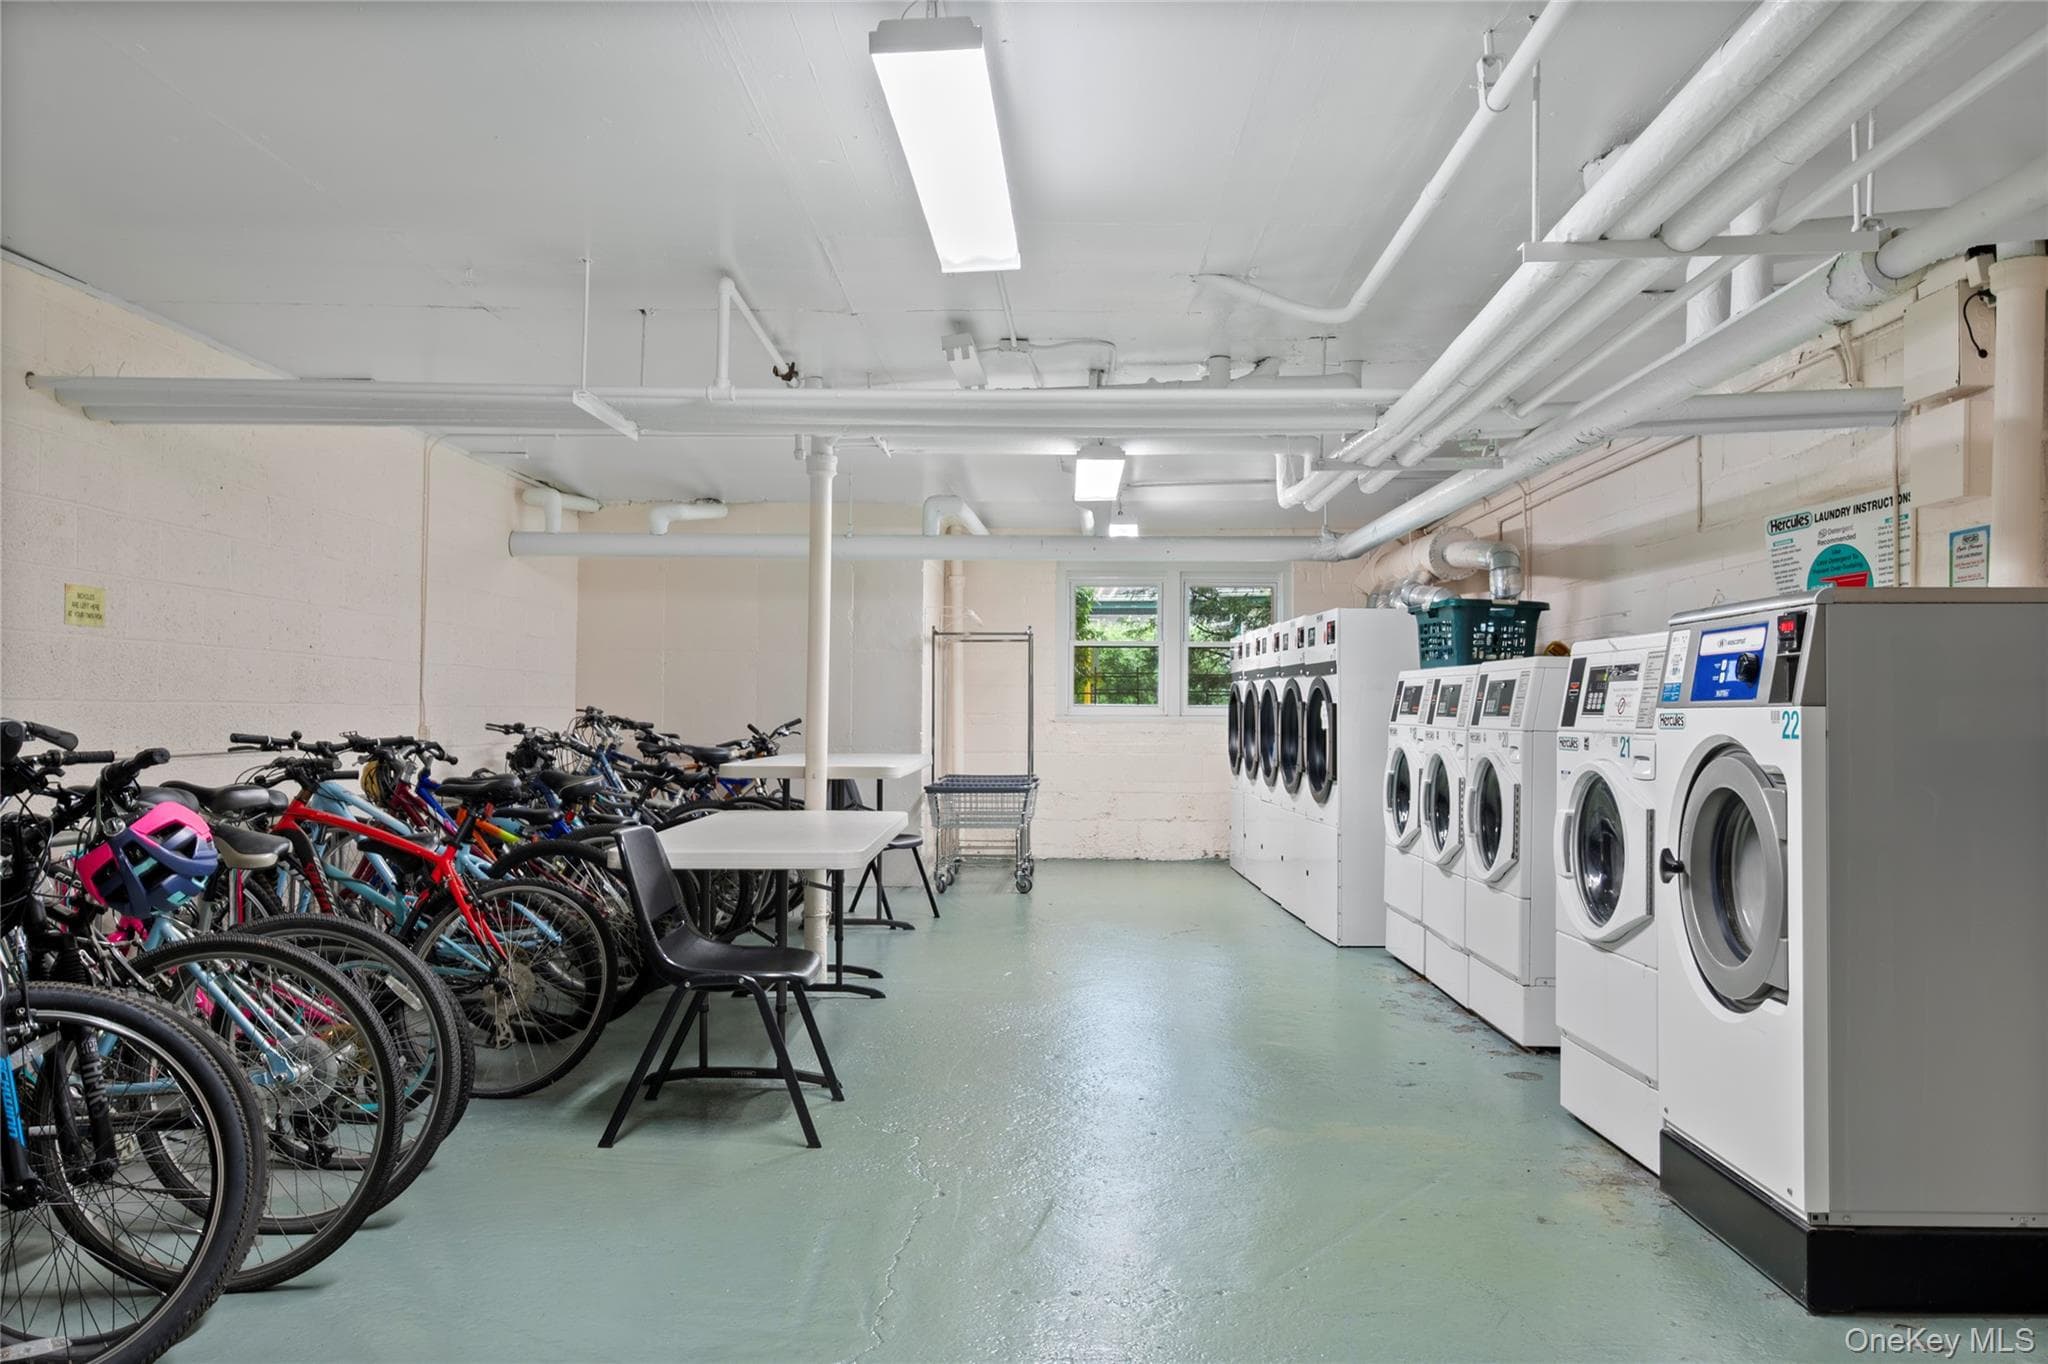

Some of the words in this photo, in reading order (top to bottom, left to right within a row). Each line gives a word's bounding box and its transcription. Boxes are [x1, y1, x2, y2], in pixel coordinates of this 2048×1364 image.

[1770, 513, 1810, 533] Hercules
[1814, 506, 1851, 524] LAUNDRY
[1853, 491, 1911, 515] INSTRUCTONS
[1817, 533, 1857, 546] Recommended
[1659, 713, 1685, 728] Hercules
[1782, 710, 1799, 739] 22
[1620, 735, 1631, 759] 21
